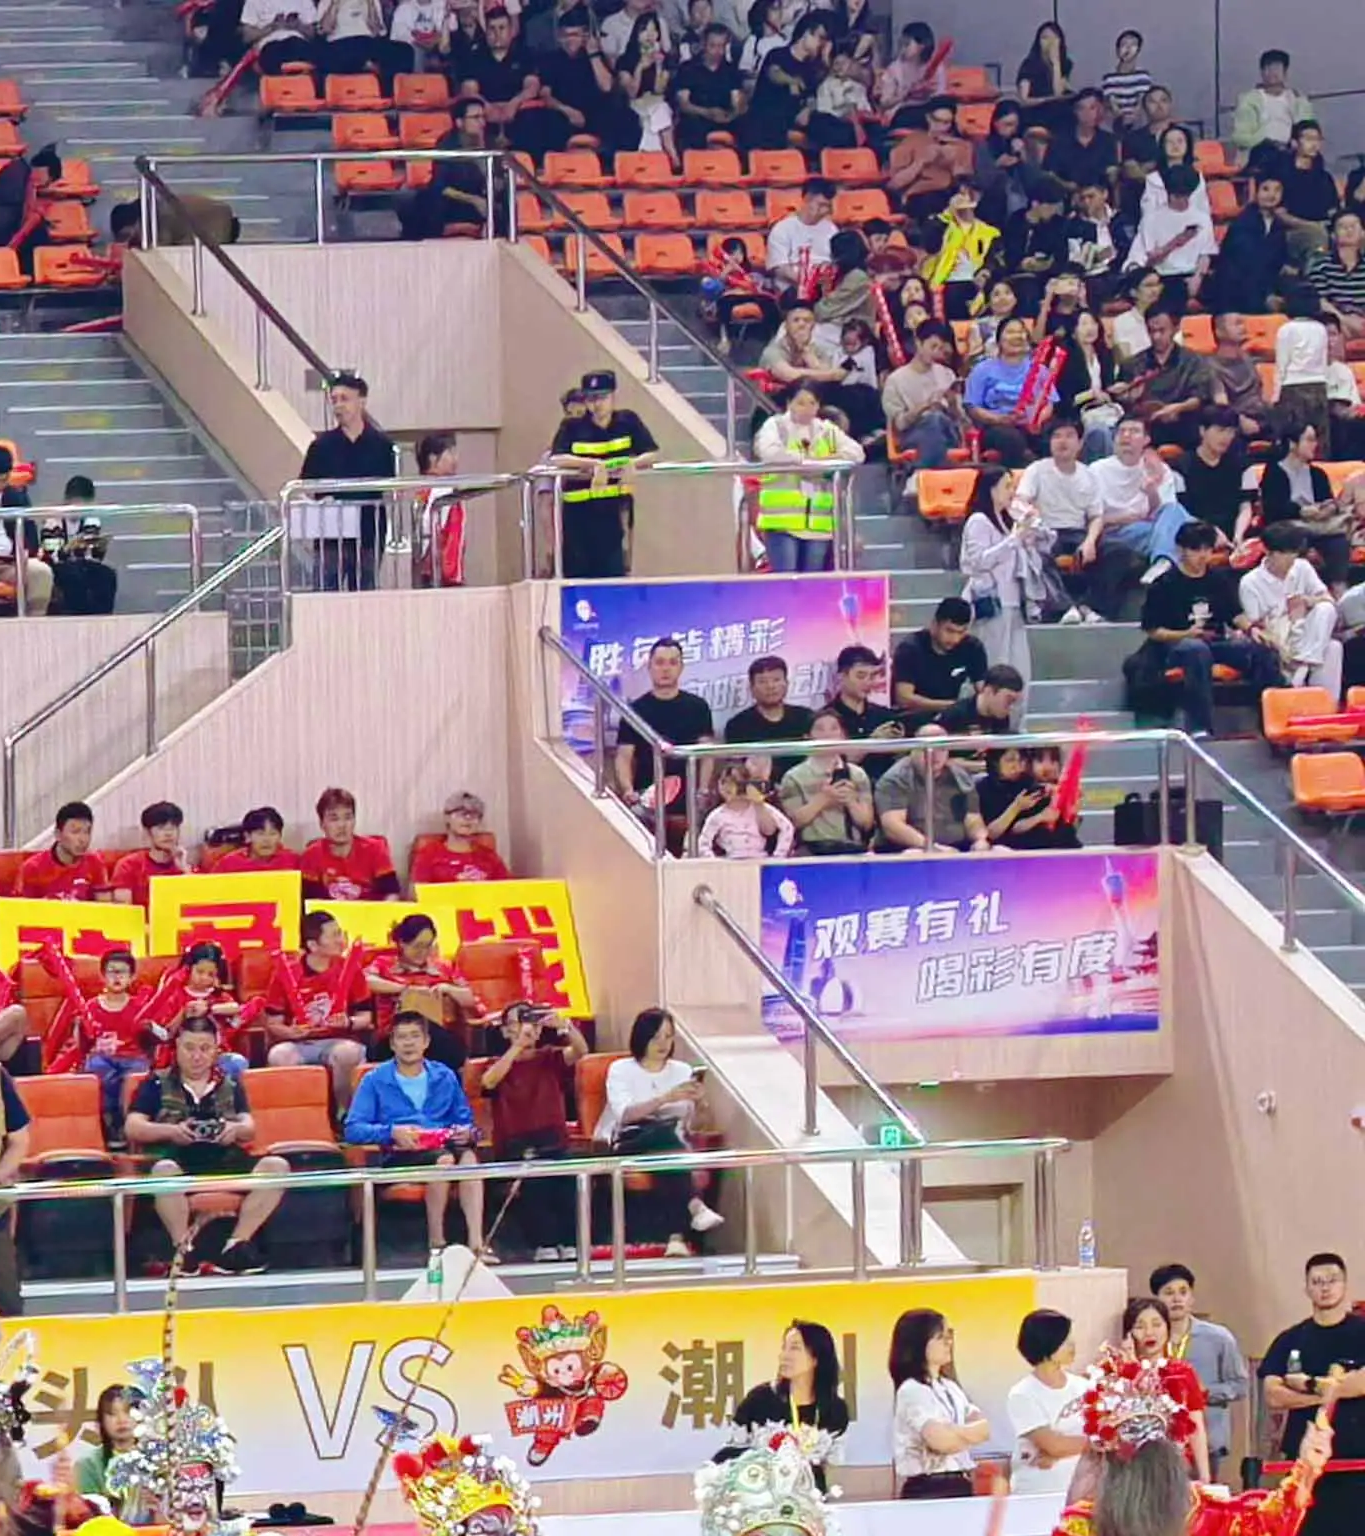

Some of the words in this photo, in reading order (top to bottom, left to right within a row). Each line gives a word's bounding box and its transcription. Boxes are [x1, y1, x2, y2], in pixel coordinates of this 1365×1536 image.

[814, 890, 1009, 960] 观赛有礼
[915, 931, 1121, 1005] 喝彩有度
[282, 1336, 460, 1460] VS
[515, 1404, 568, 1429] 潮州
